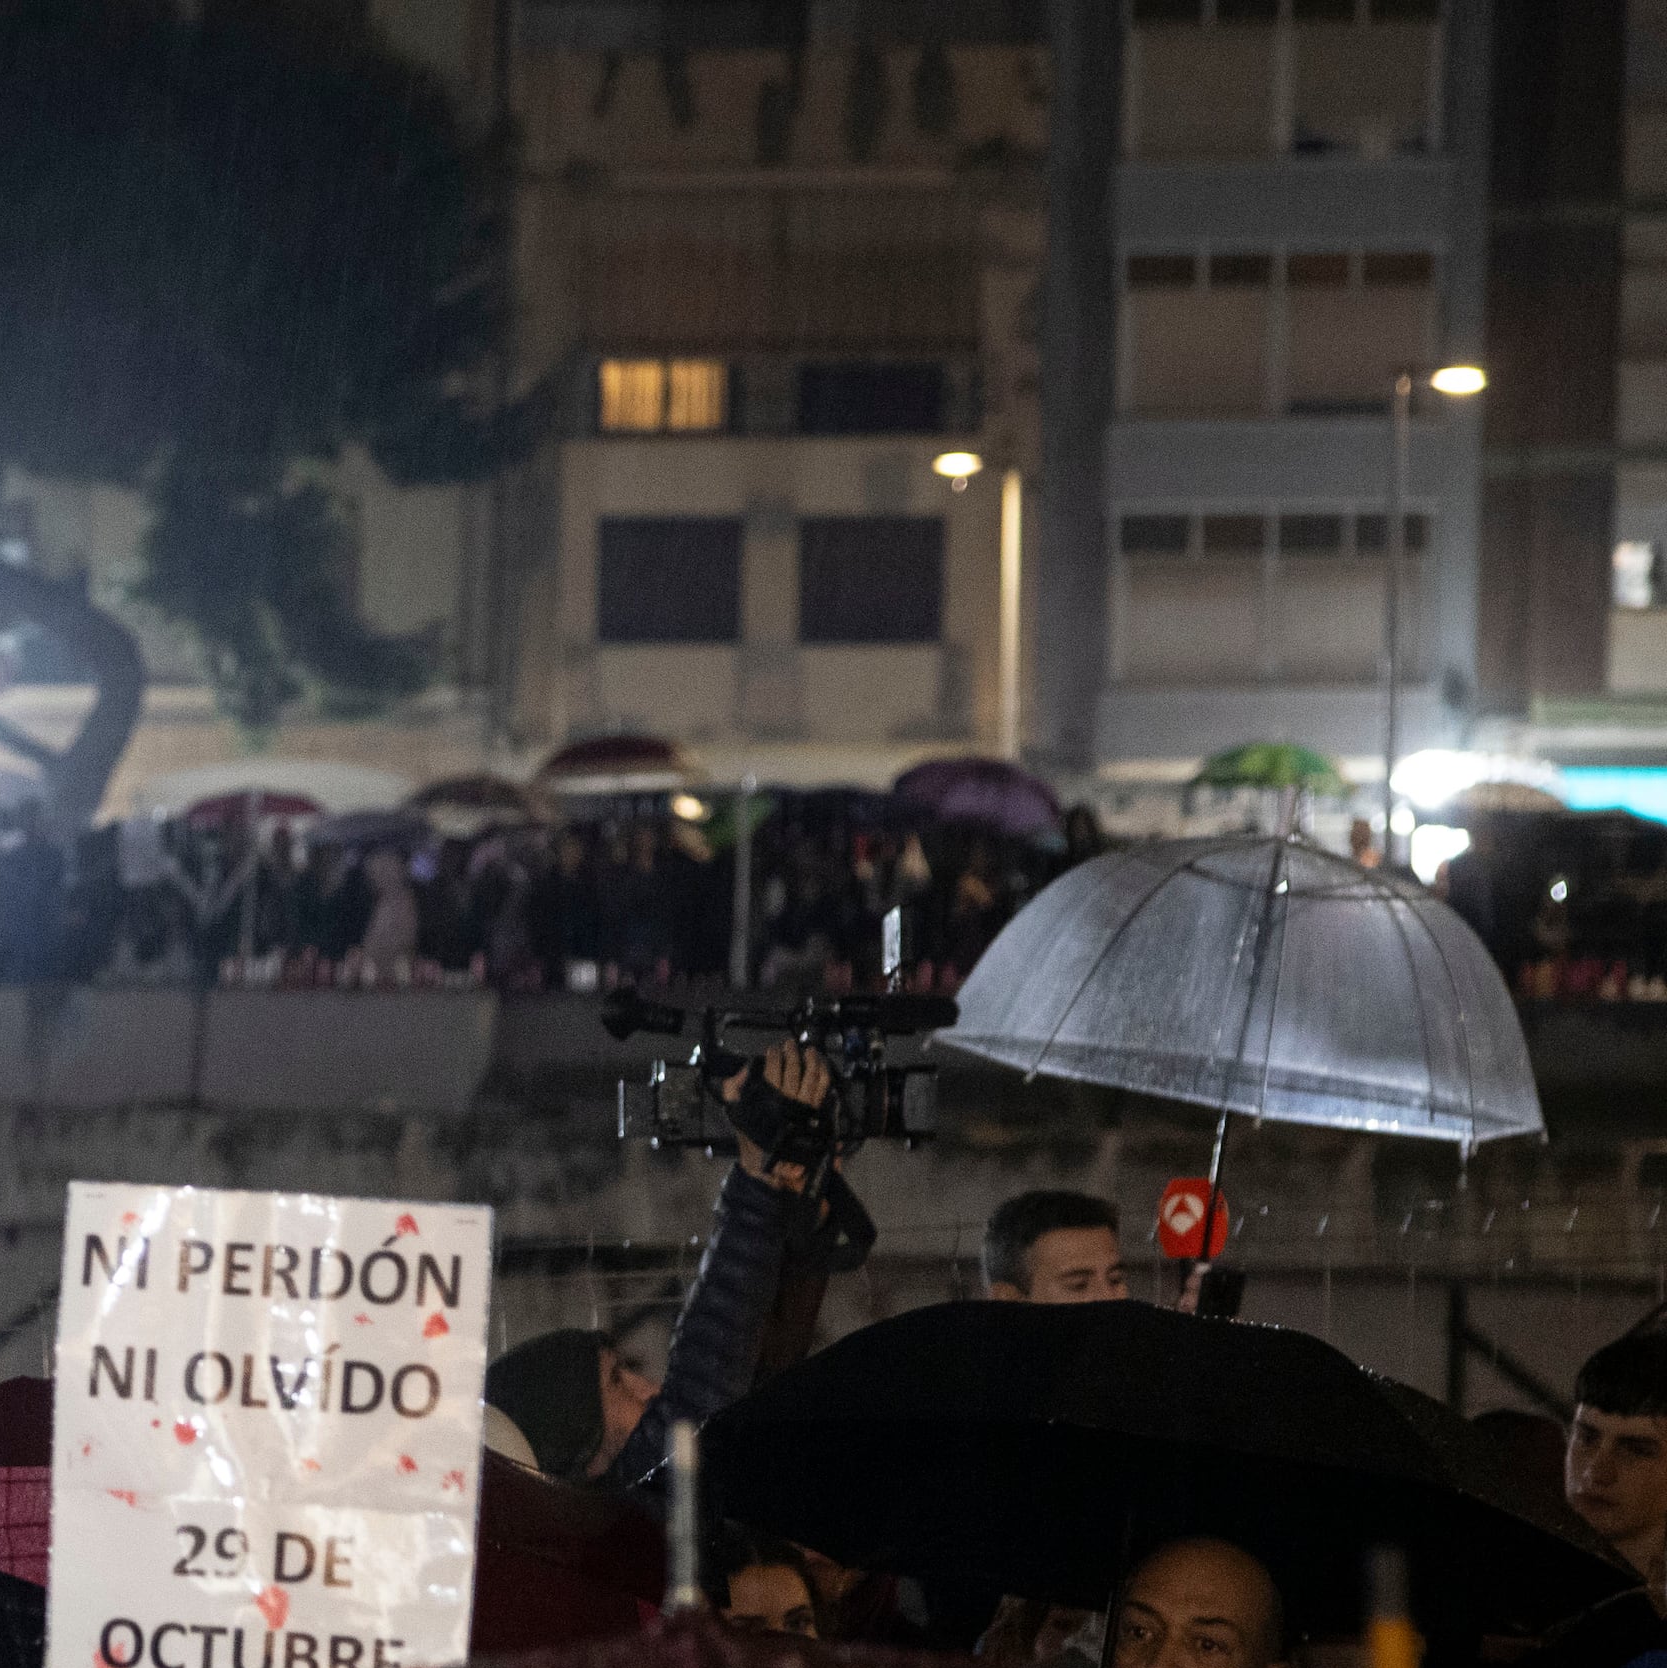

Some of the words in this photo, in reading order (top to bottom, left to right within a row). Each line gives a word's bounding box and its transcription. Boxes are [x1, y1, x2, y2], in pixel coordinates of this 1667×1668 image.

[81, 1233, 148, 1290] NI
[176, 1236, 462, 1309] PERDÓN
[88, 1344, 158, 1402] NI
[172, 1524, 249, 1579] 29
[273, 1531, 354, 1588] DE
